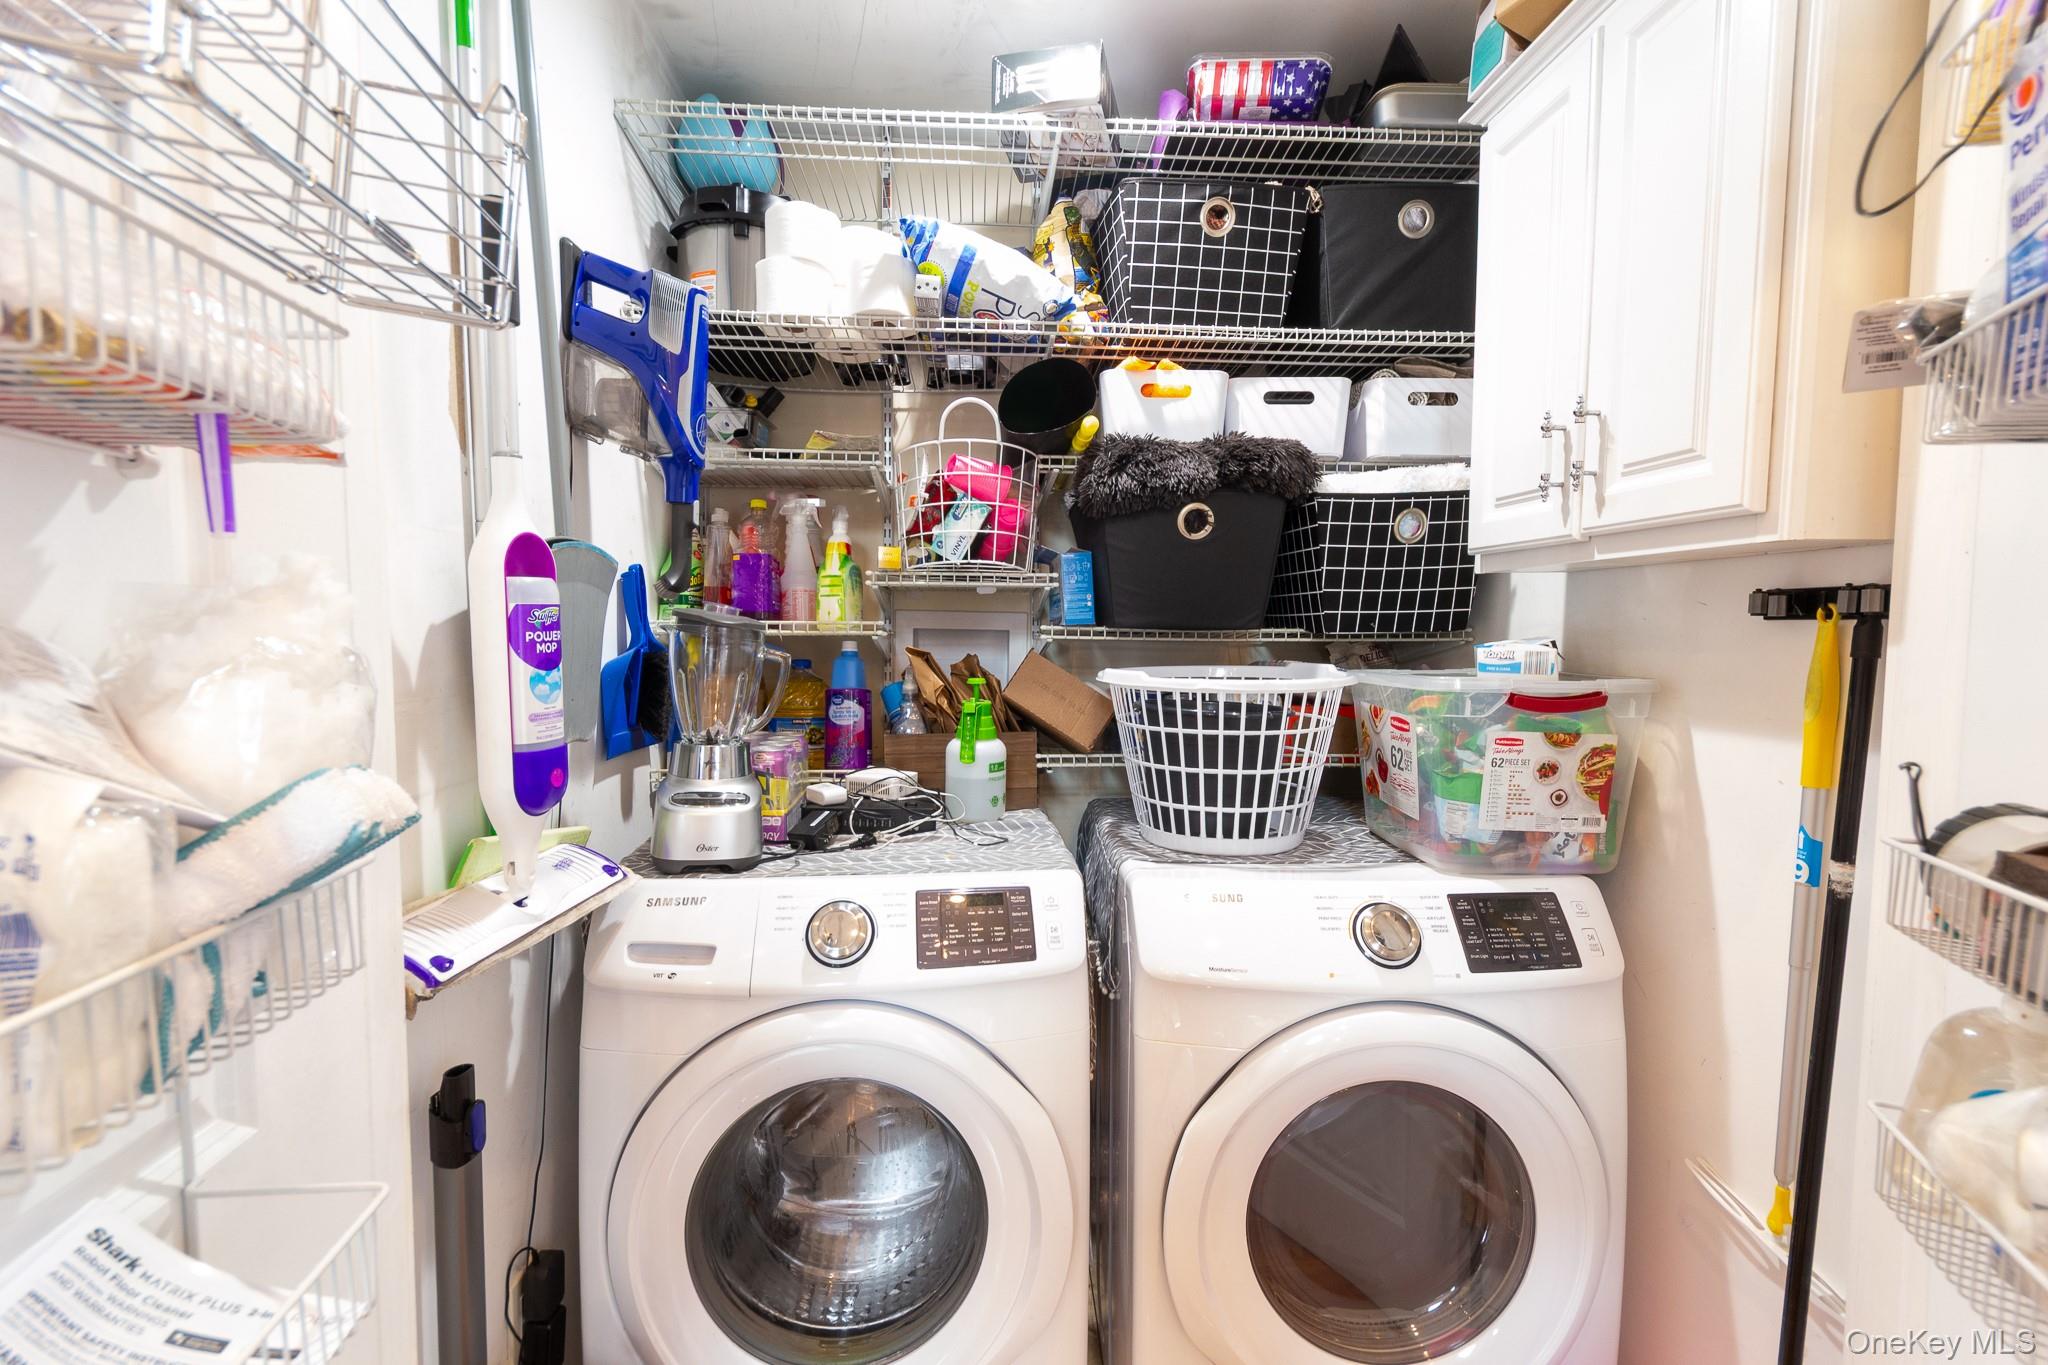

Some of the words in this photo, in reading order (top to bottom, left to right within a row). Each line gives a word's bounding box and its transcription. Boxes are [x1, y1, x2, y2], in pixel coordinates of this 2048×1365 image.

[951, 535, 967, 556] VINYL
[528, 608, 560, 625] Swiffer
[536, 642, 558, 653] MOP
[1390, 745, 1404, 772] 62
[1491, 757, 1505, 768] 62
[696, 843, 720, 853] Oster
[48, 1269, 74, 1291] AND
[86, 1227, 143, 1273] Shark
[138, 1270, 195, 1302] MATRIX
[198, 1296, 243, 1314] PLUS
[73, 1246, 110, 1277] Robot
[109, 1272, 141, 1299] Floor
[141, 1294, 195, 1320] Cleaner
